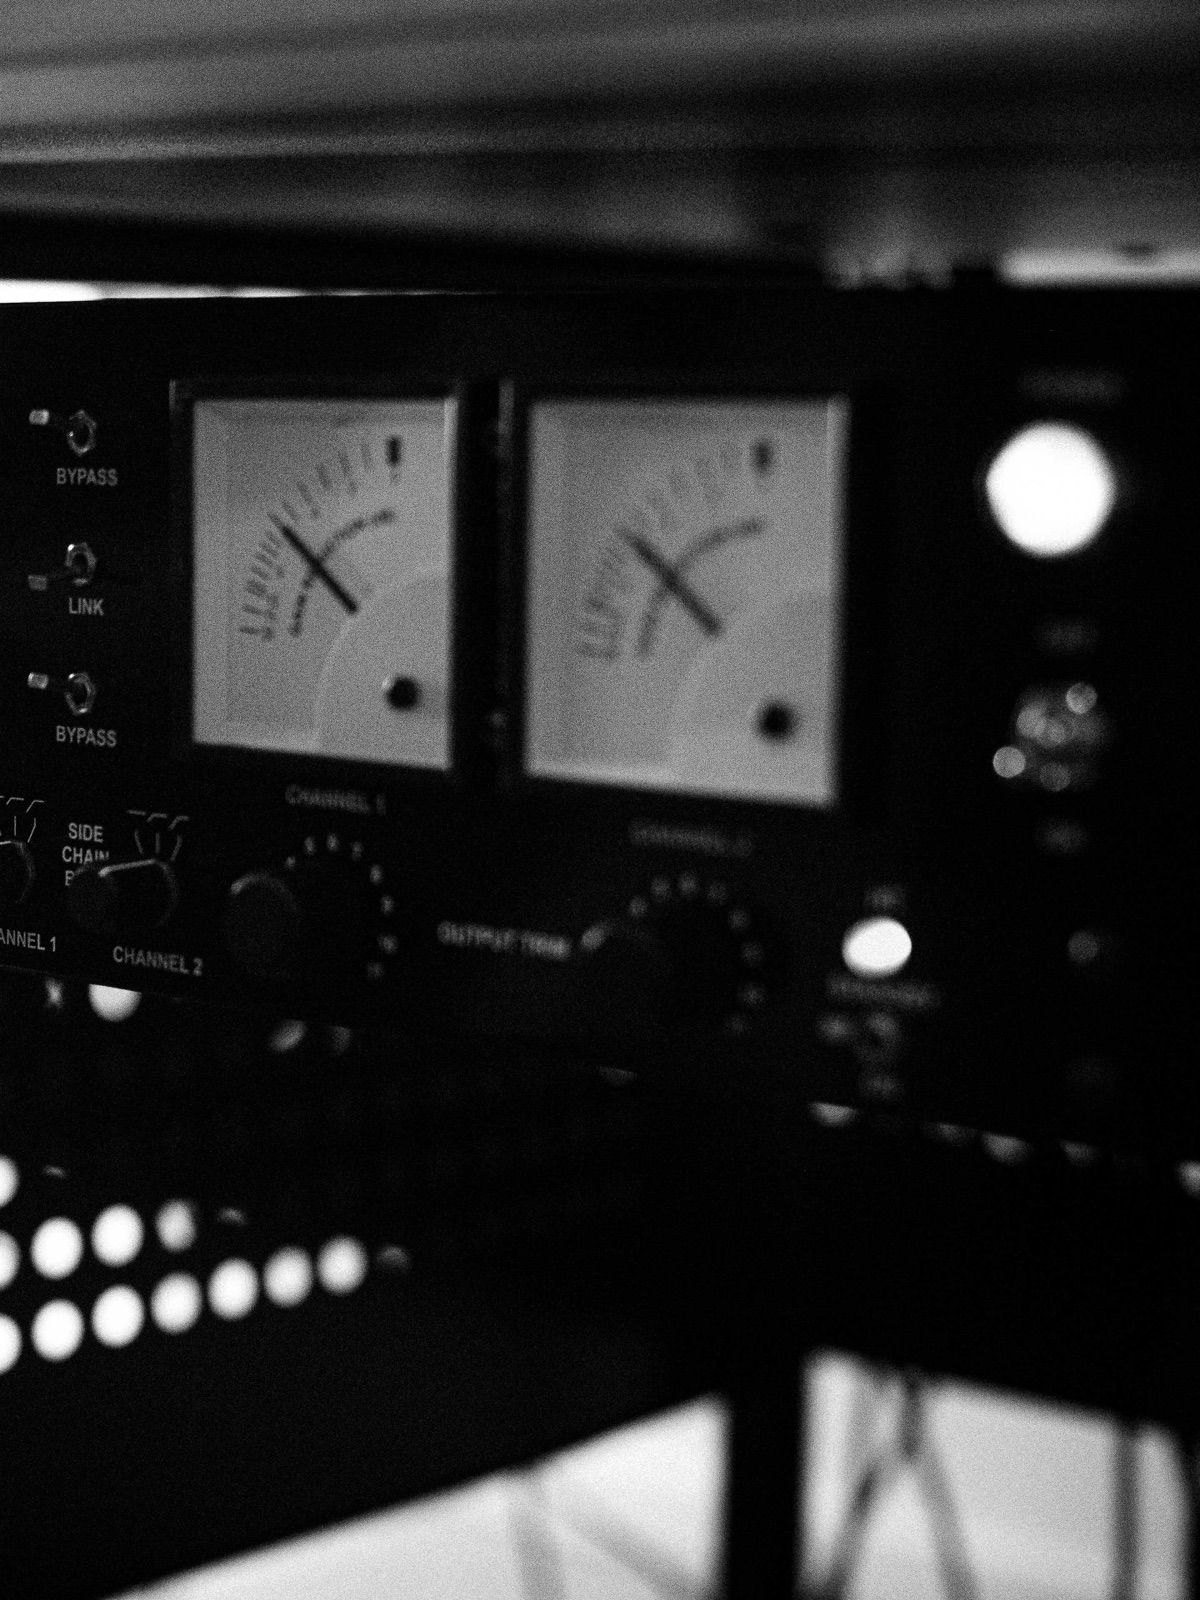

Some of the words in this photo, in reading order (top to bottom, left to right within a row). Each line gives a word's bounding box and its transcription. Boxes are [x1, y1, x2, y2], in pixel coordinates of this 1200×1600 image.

[57, 468, 118, 486] BYPASS
[69, 598, 104, 615] LINK
[56, 725, 116, 747] BYPASS
[69, 822, 103, 843] SIDE
[49, 936, 57, 953] 1
[113, 946, 189, 974] CHANNEL
[192, 957, 203, 977] 2
